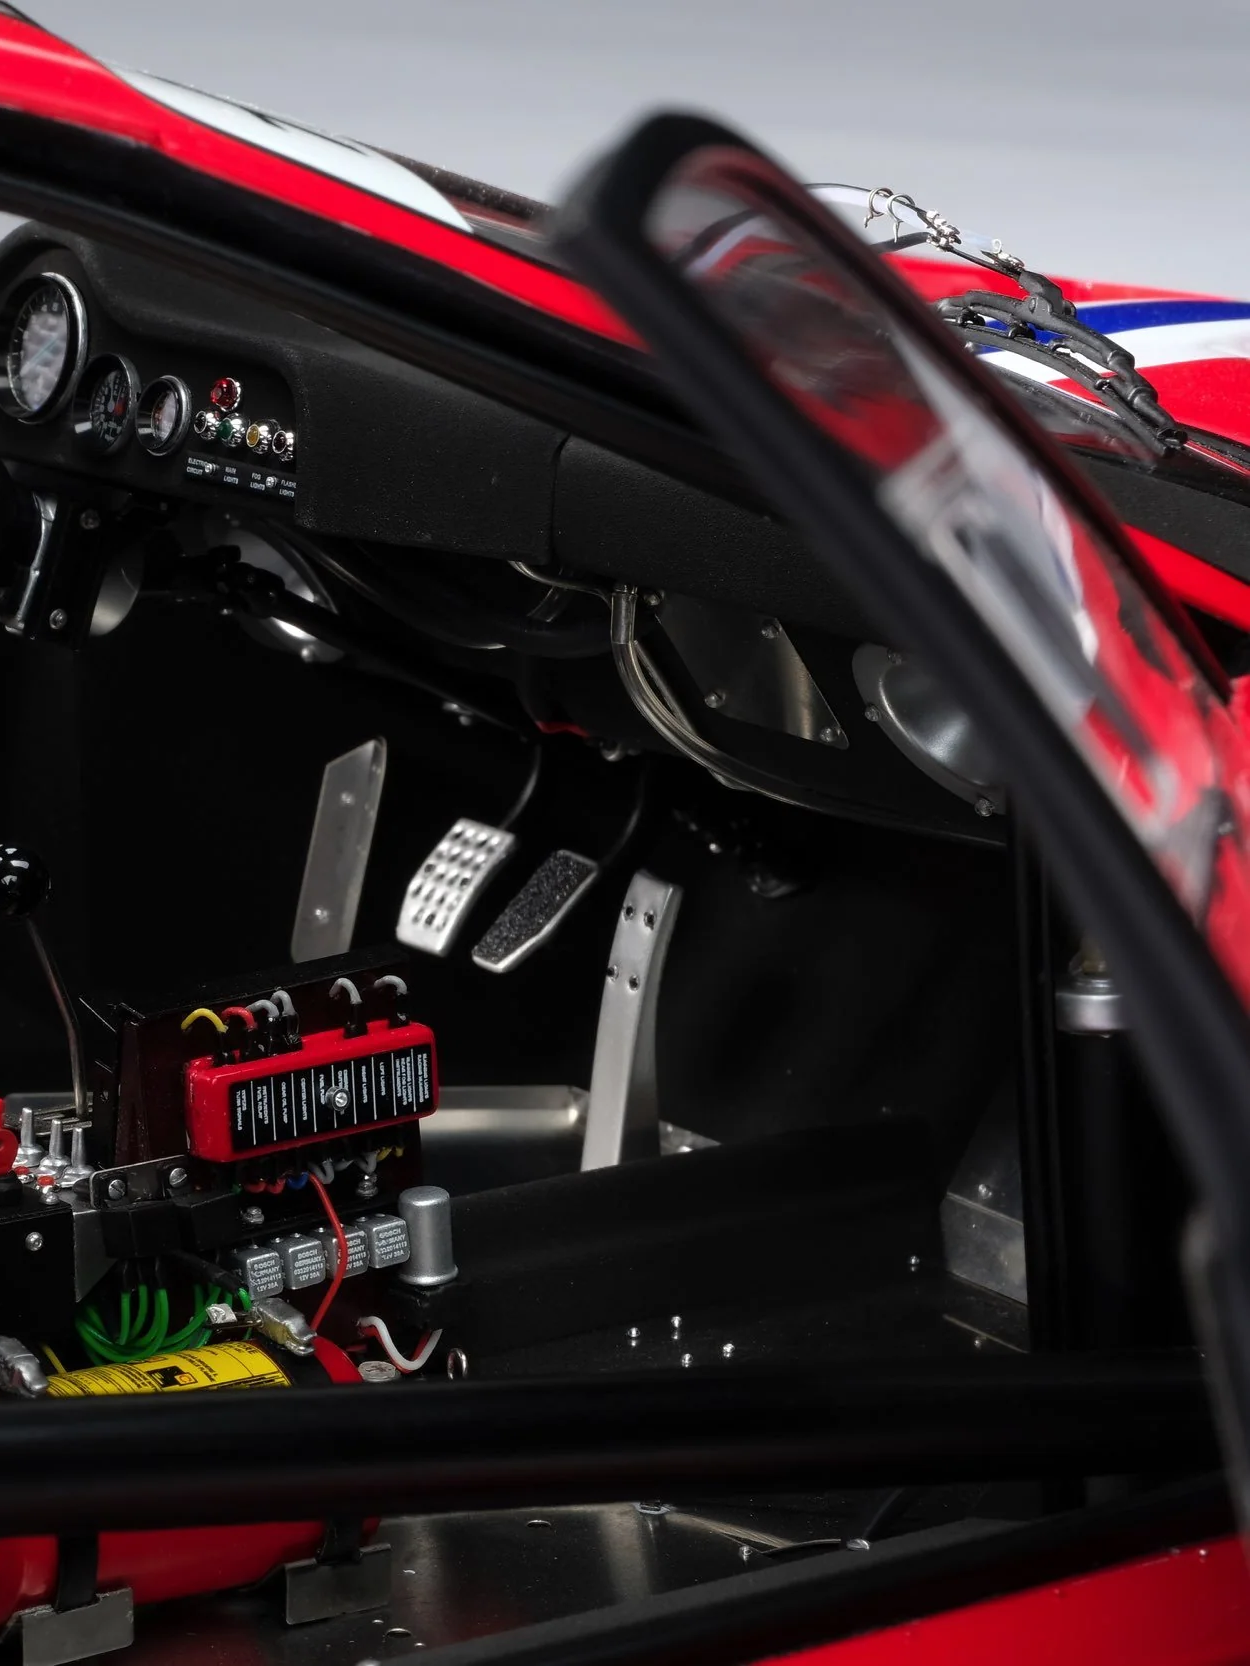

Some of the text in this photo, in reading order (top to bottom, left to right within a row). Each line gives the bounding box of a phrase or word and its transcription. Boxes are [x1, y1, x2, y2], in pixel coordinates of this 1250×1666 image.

[186, 466, 203, 475] CIRCUIT
[223, 475, 239, 485] LIGHTS
[252, 472, 261, 480] FOG
[250, 482, 266, 491] LIGHTS
[279, 489, 295, 498] LIGHTS
[298, 1249, 318, 1260] BOSCH
[294, 1255, 322, 1268] GERMANY
